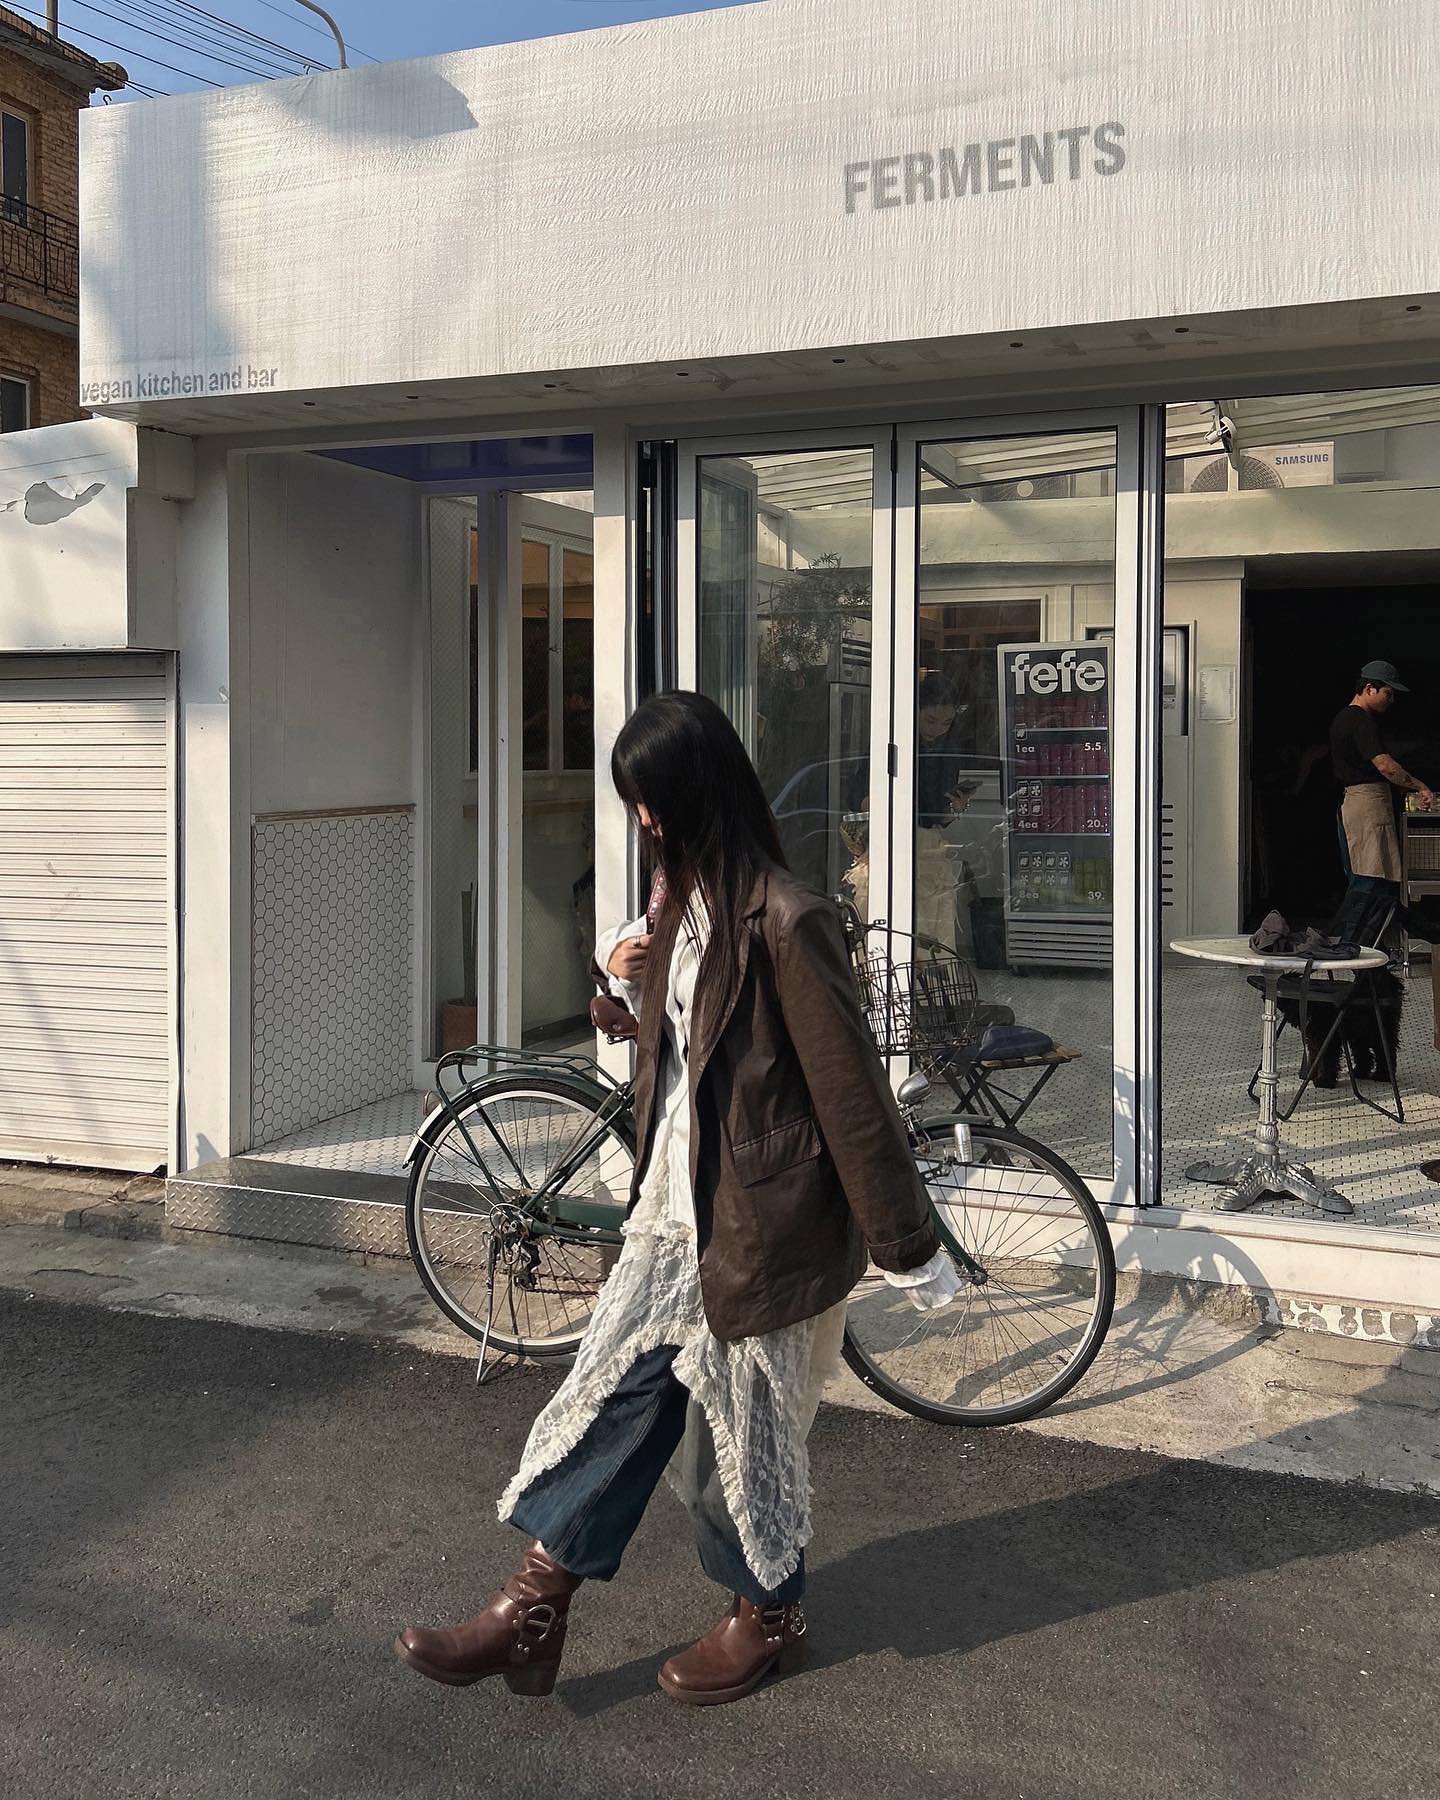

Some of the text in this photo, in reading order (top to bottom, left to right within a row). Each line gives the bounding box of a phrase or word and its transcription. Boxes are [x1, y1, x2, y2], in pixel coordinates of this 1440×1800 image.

[844, 121, 1126, 214] FERMENTS
[81, 365, 278, 403] vegan kitchen and bar
[1275, 453, 1329, 465] SAMSUNG
[1010, 650, 1106, 695] fefe
[1015, 744, 1035, 753] 1ea
[1018, 820, 1039, 829] 4ea
